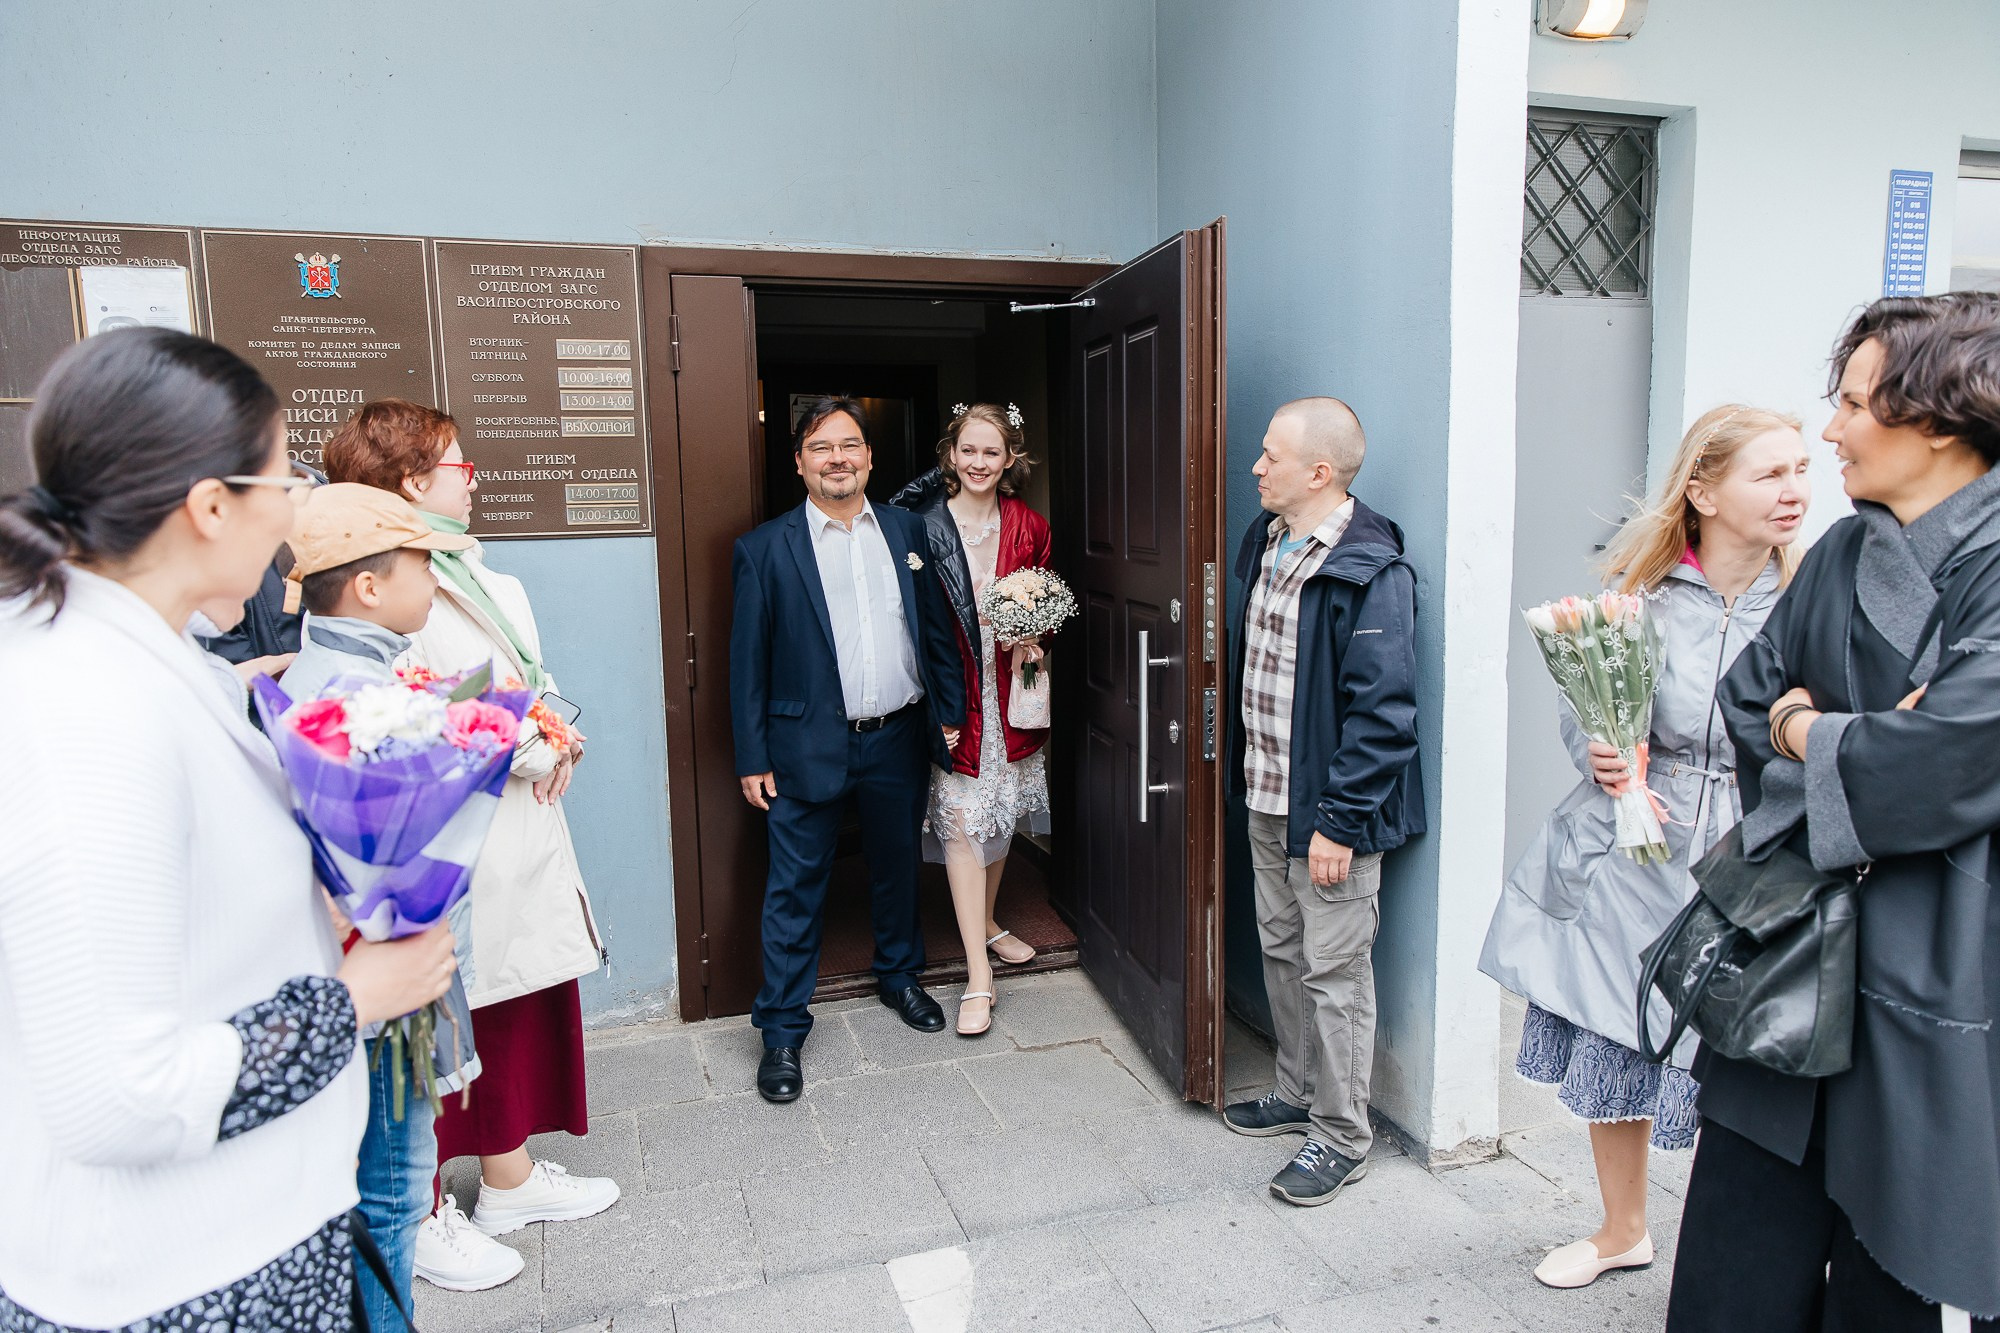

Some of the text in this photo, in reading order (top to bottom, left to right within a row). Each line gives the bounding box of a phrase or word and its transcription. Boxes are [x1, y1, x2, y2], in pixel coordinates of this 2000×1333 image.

[18, 229, 122, 243] ИНФОРМАЦИЯ
[22, 243, 122, 256] ОТДЕЛА ЗАГС
[126, 256, 178, 267] РАЙОНА
[470, 264, 606, 280] ПРИЕМ ГРАЖДАН
[478, 280, 598, 295] ОТДЕЛОМ ЗАГС
[456, 295, 622, 311] ВАСИЛЕОСТРОВСКОГО
[280, 315, 367, 325] ПРАВИТЕЛЬСТВО
[513, 311, 572, 325] РАЙОНА
[272, 325, 376, 334] САНКТ-ПЕТЕРБУРГА
[248, 340, 401, 350] КОМИТЕТ ПО ДЕЛАМ ЗАПИСИ
[560, 343, 628, 356] 10.00-17.00
[265, 350, 388, 360] АКТОВ ГРАЖДАНСКОГО
[470, 352, 528, 362] ПЯТНИЦА
[296, 360, 357, 369] СОСТОЯНИЯ
[471, 373, 524, 383] СУББОТА
[563, 372, 630, 384] 10.00-16.00
[291, 388, 365, 406] ОТДЕЛ
[473, 395, 528, 404] ПЕРЕРЫВ
[565, 395, 632, 406] 13.00-14.00
[565, 420, 631, 434] ВЫХОДНОЙ
[476, 429, 560, 440] ПОНЕДЕЛЬНИК
[526, 454, 577, 465] ПРИЕМ
[473, 468, 638, 481] АЧАЛЬНИКОМ ОТДЕЛА
[481, 494, 535, 503] ВТОРНИК
[570, 488, 636, 499] 14.00-17.00
[482, 511, 534, 521] ЧЕТВЕРГ
[571, 510, 637, 521] 10.00-13.00
